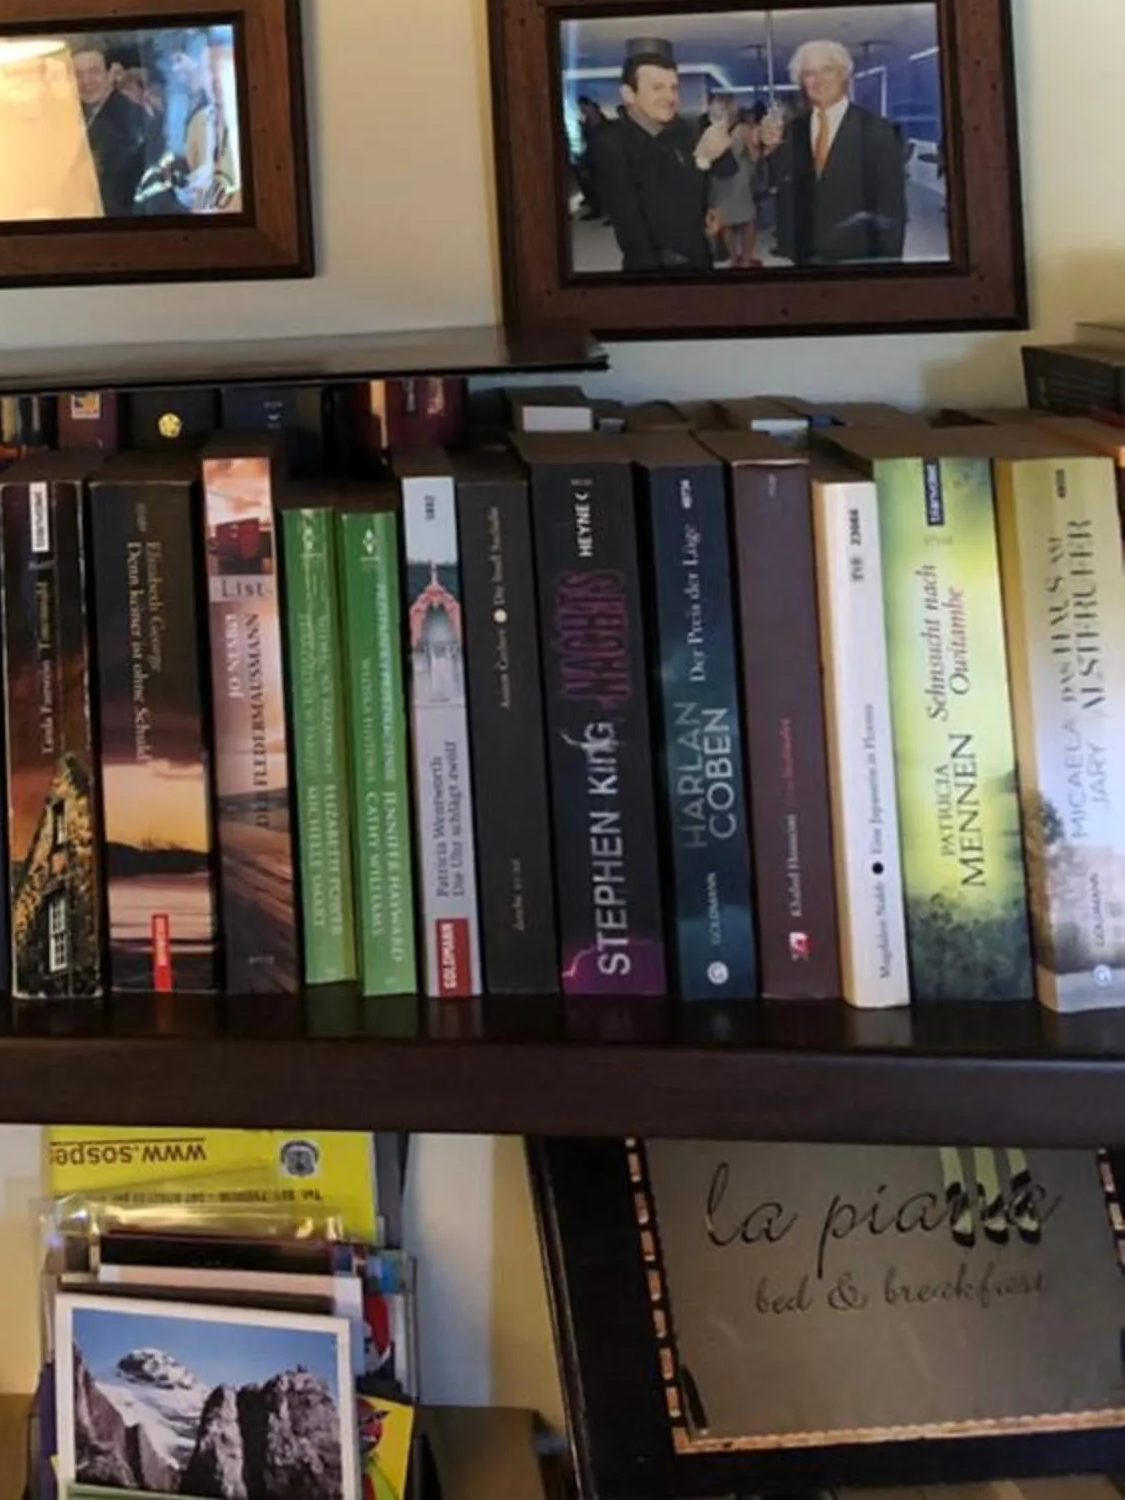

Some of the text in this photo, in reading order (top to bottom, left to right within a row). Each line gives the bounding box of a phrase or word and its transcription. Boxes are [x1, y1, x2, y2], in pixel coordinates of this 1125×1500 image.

[576, 503, 593, 558] HEYNE
[223, 613, 243, 699] JO NESBØ
[679, 524, 706, 682] Der Preis der Lüge
[915, 564, 950, 722] Sehnsucht nach
[246, 612, 269, 786] FLEDERMAUSMANN
[429, 756, 451, 897] Patricia Wentworth
[673, 701, 708, 848] HARLAN
[701, 707, 737, 839] COBEN
[933, 763, 954, 858] PATRICIA
[949, 732, 988, 888] MENNEN
[1061, 718, 1089, 838] MICAELA
[1087, 740, 1107, 805] JARY
[441, 922, 457, 990] GOLDMANN
[589, 810, 632, 976] STEPHEN
[706, 1162, 797, 1246] la
[755, 1273, 813, 1315] bed
[827, 1272, 869, 1311] &
